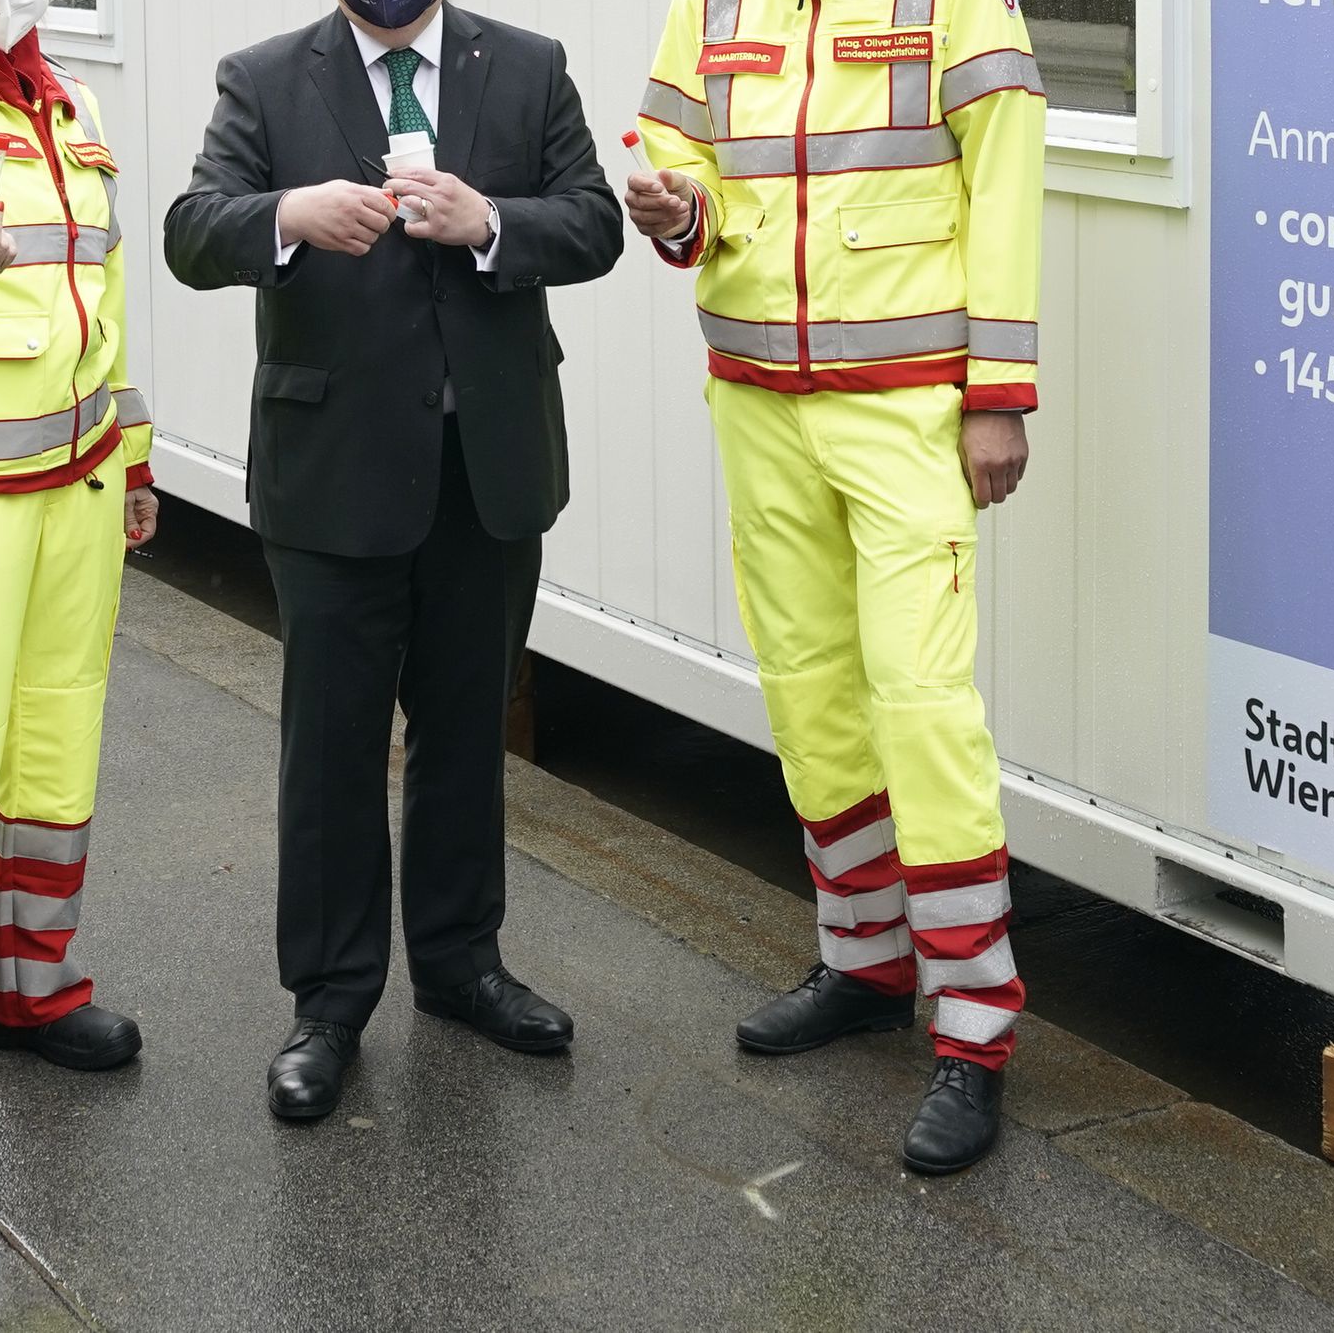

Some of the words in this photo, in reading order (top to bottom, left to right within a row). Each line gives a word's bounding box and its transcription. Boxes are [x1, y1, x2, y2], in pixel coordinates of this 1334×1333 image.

[837, 38, 861, 49] Mag.
[864, 37, 892, 48] Oliver
[894, 35, 929, 46] Löhlein
[708, 52, 772, 63] SAMARITERBUND
[837, 47, 929, 59] Landesgeschäftsführer
